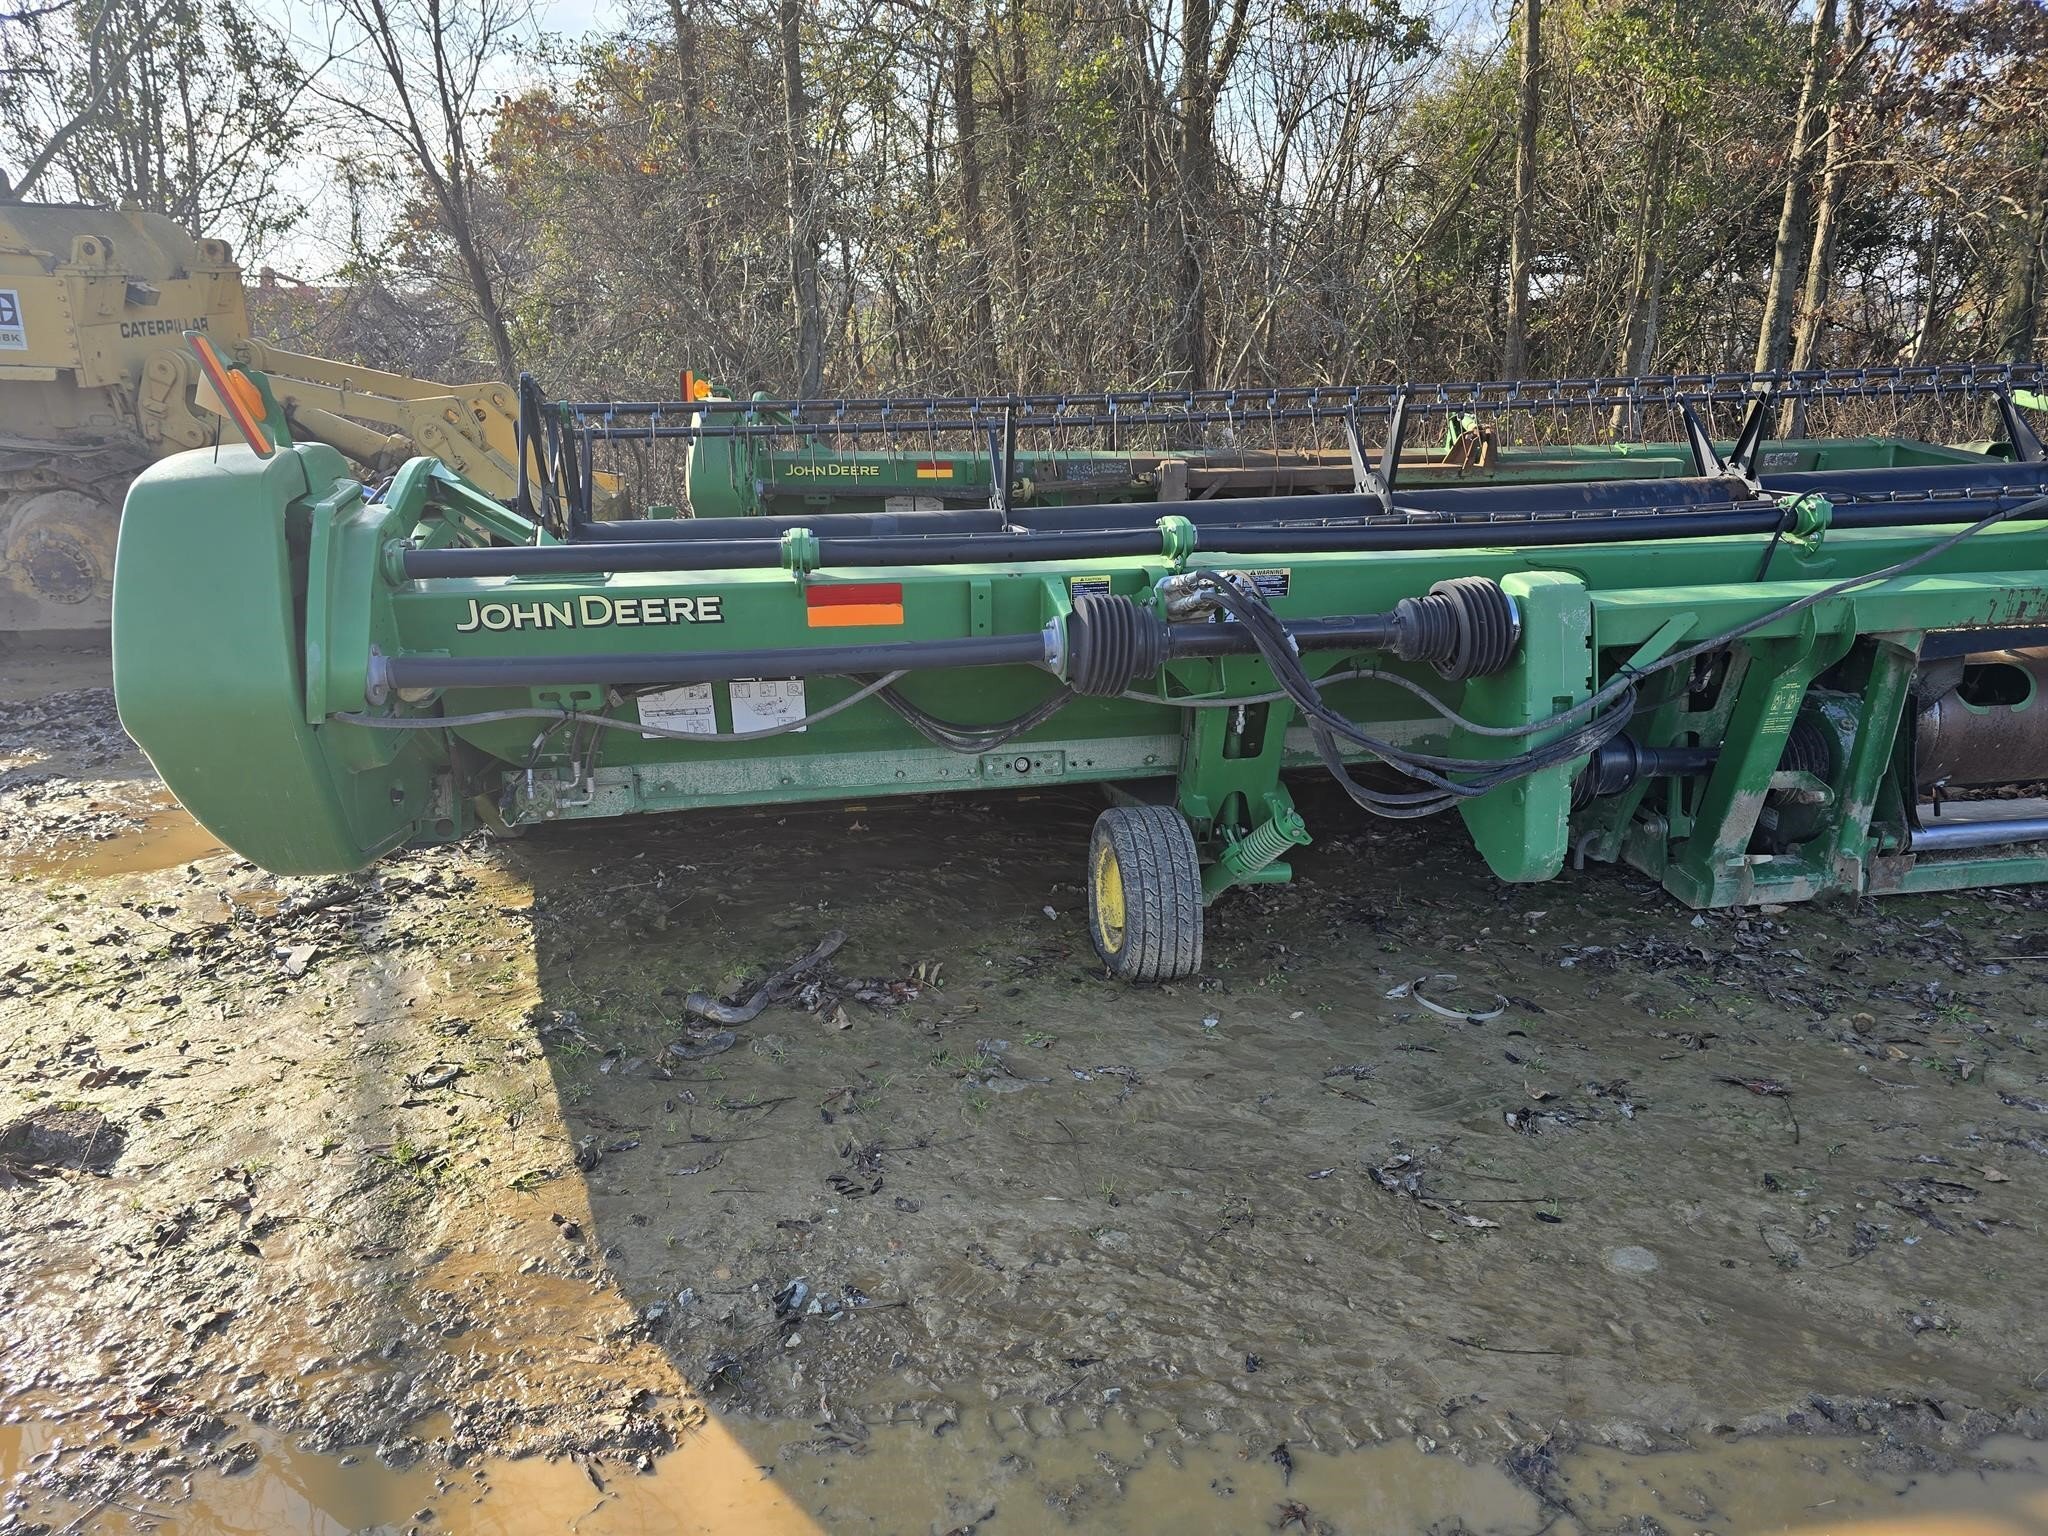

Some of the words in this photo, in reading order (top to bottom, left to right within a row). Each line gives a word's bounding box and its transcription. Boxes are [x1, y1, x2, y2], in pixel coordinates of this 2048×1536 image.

[120, 317, 208, 338] CATERPILLAR
[785, 464, 826, 476] JOHN
[828, 464, 880, 476] DEERE
[456, 599, 576, 632] JOHN
[578, 595, 724, 627] DEERE
